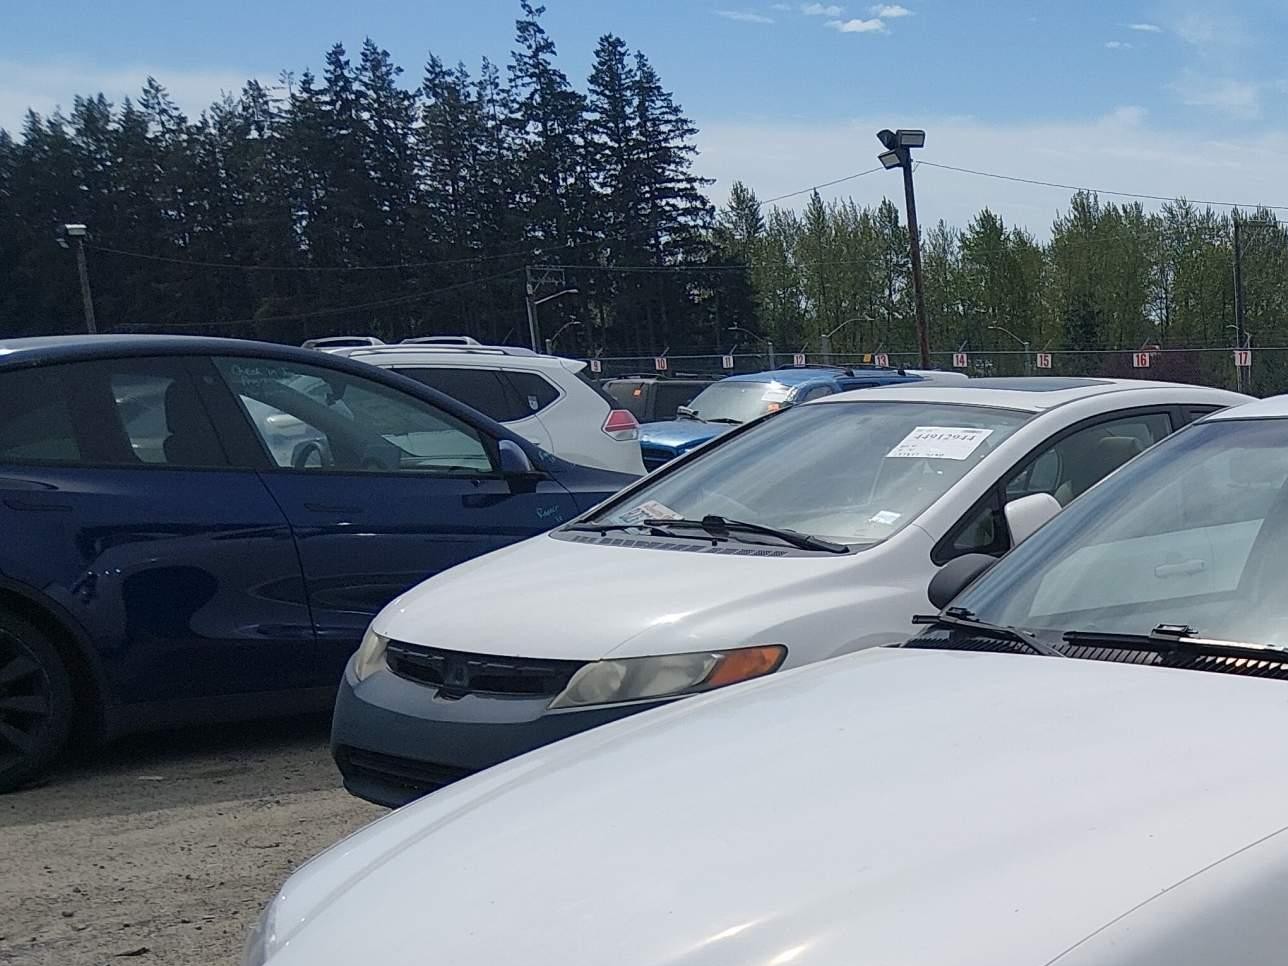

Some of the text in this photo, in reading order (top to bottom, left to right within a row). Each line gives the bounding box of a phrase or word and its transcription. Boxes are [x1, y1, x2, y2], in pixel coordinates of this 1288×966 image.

[795, 355, 804, 365] 12
[877, 354, 887, 366] 13
[955, 354, 965, 366] 14
[1040, 355, 1049, 367] 15
[1136, 354, 1147, 366] 16
[1238, 352, 1248, 365] 17
